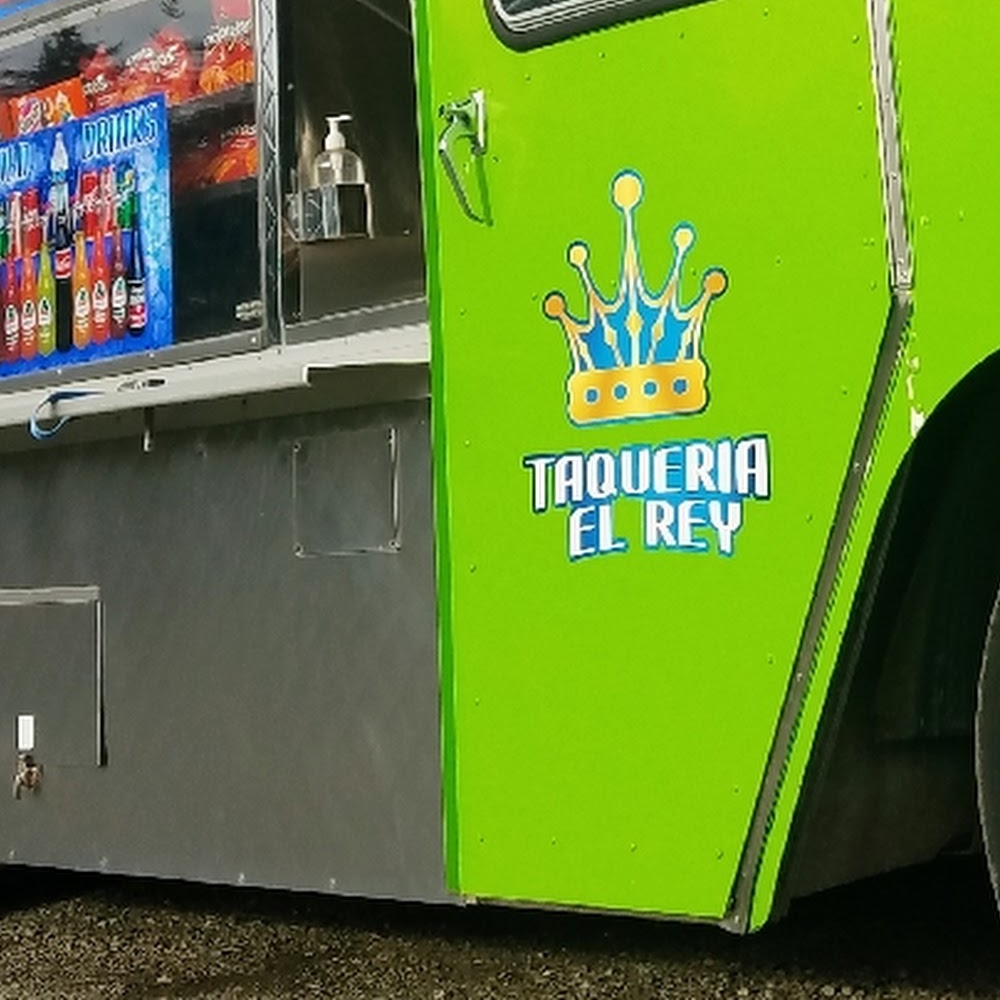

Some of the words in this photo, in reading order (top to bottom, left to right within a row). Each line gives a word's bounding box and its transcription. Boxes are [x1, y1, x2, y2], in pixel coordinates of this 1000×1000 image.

[82, 101, 158, 162] DRINKS
[523, 434, 771, 513] TAQUERIA
[567, 503, 628, 561] EL
[643, 499, 743, 556] REY
